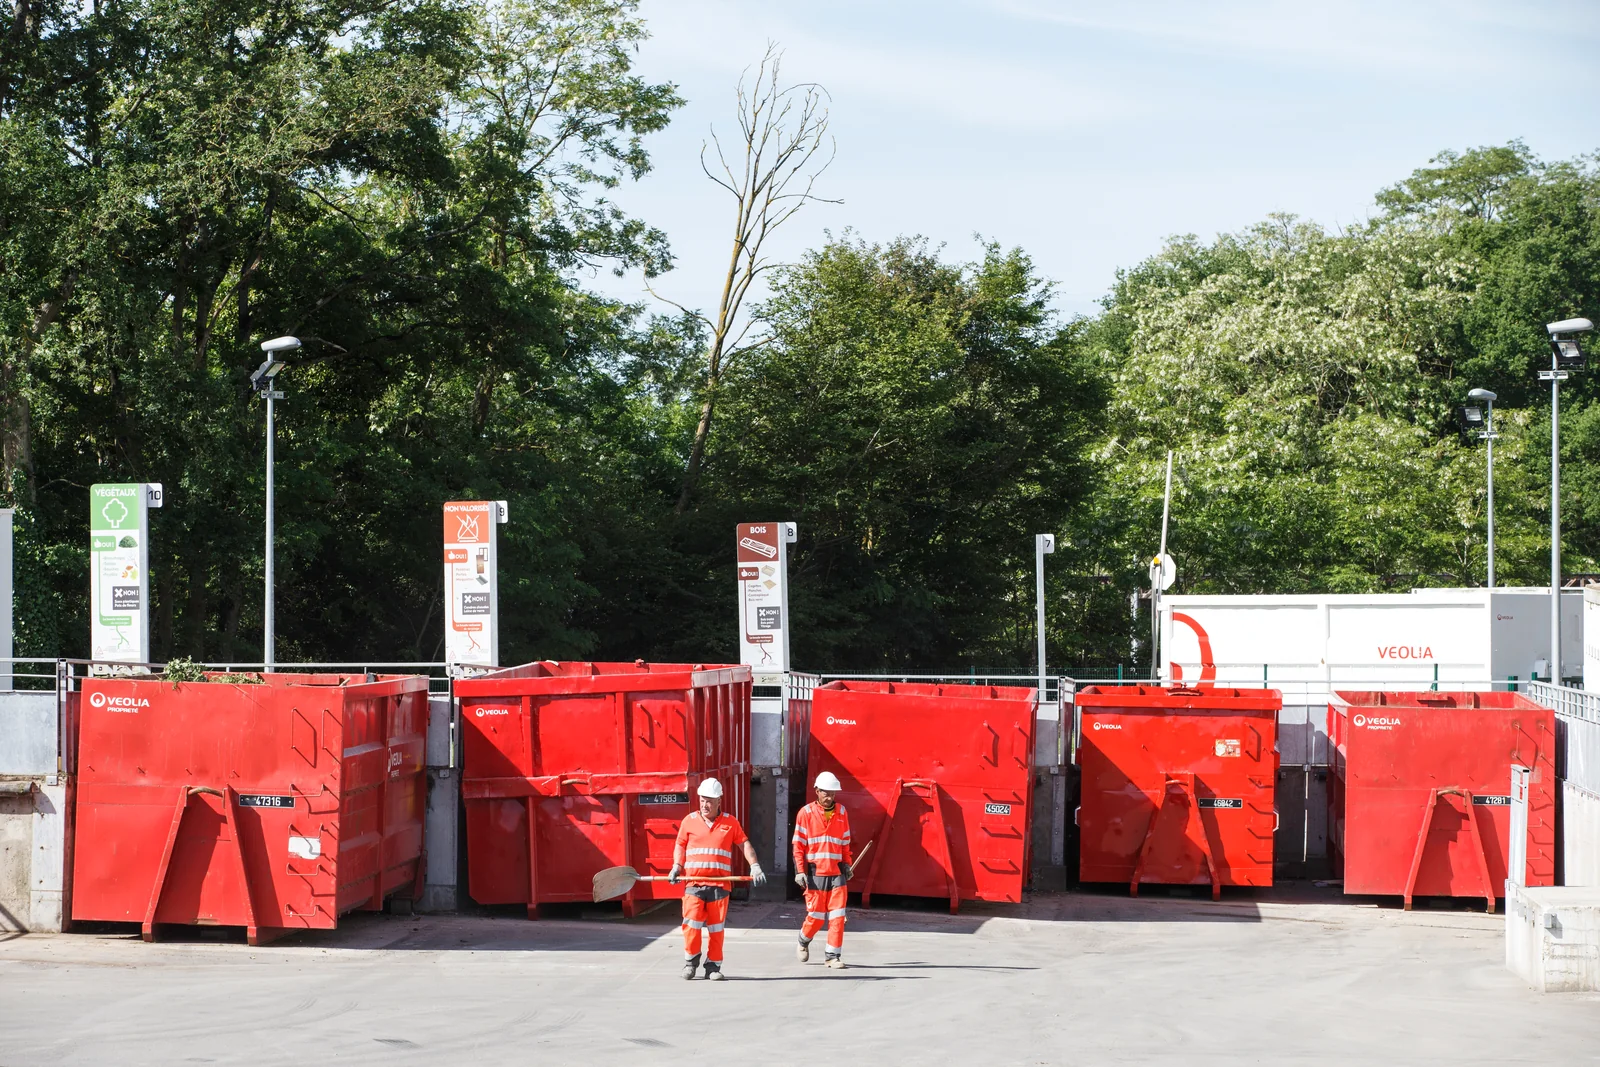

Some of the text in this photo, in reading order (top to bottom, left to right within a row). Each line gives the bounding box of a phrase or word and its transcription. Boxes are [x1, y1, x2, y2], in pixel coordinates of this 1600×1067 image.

[94, 486, 136, 497] VÉGÉTAUX
[148, 490, 161, 500] 10
[499, 507, 505, 517] 9
[750, 526, 766, 534] BOIS
[788, 528, 794, 537] 8
[1045, 540, 1050, 548] 7
[1377, 646, 1433, 659] VEOLIA
[107, 696, 150, 707] VEOLIA
[255, 796, 281, 806] 47316
[654, 794, 677, 802] 47583
[986, 804, 1008, 814] 45024
